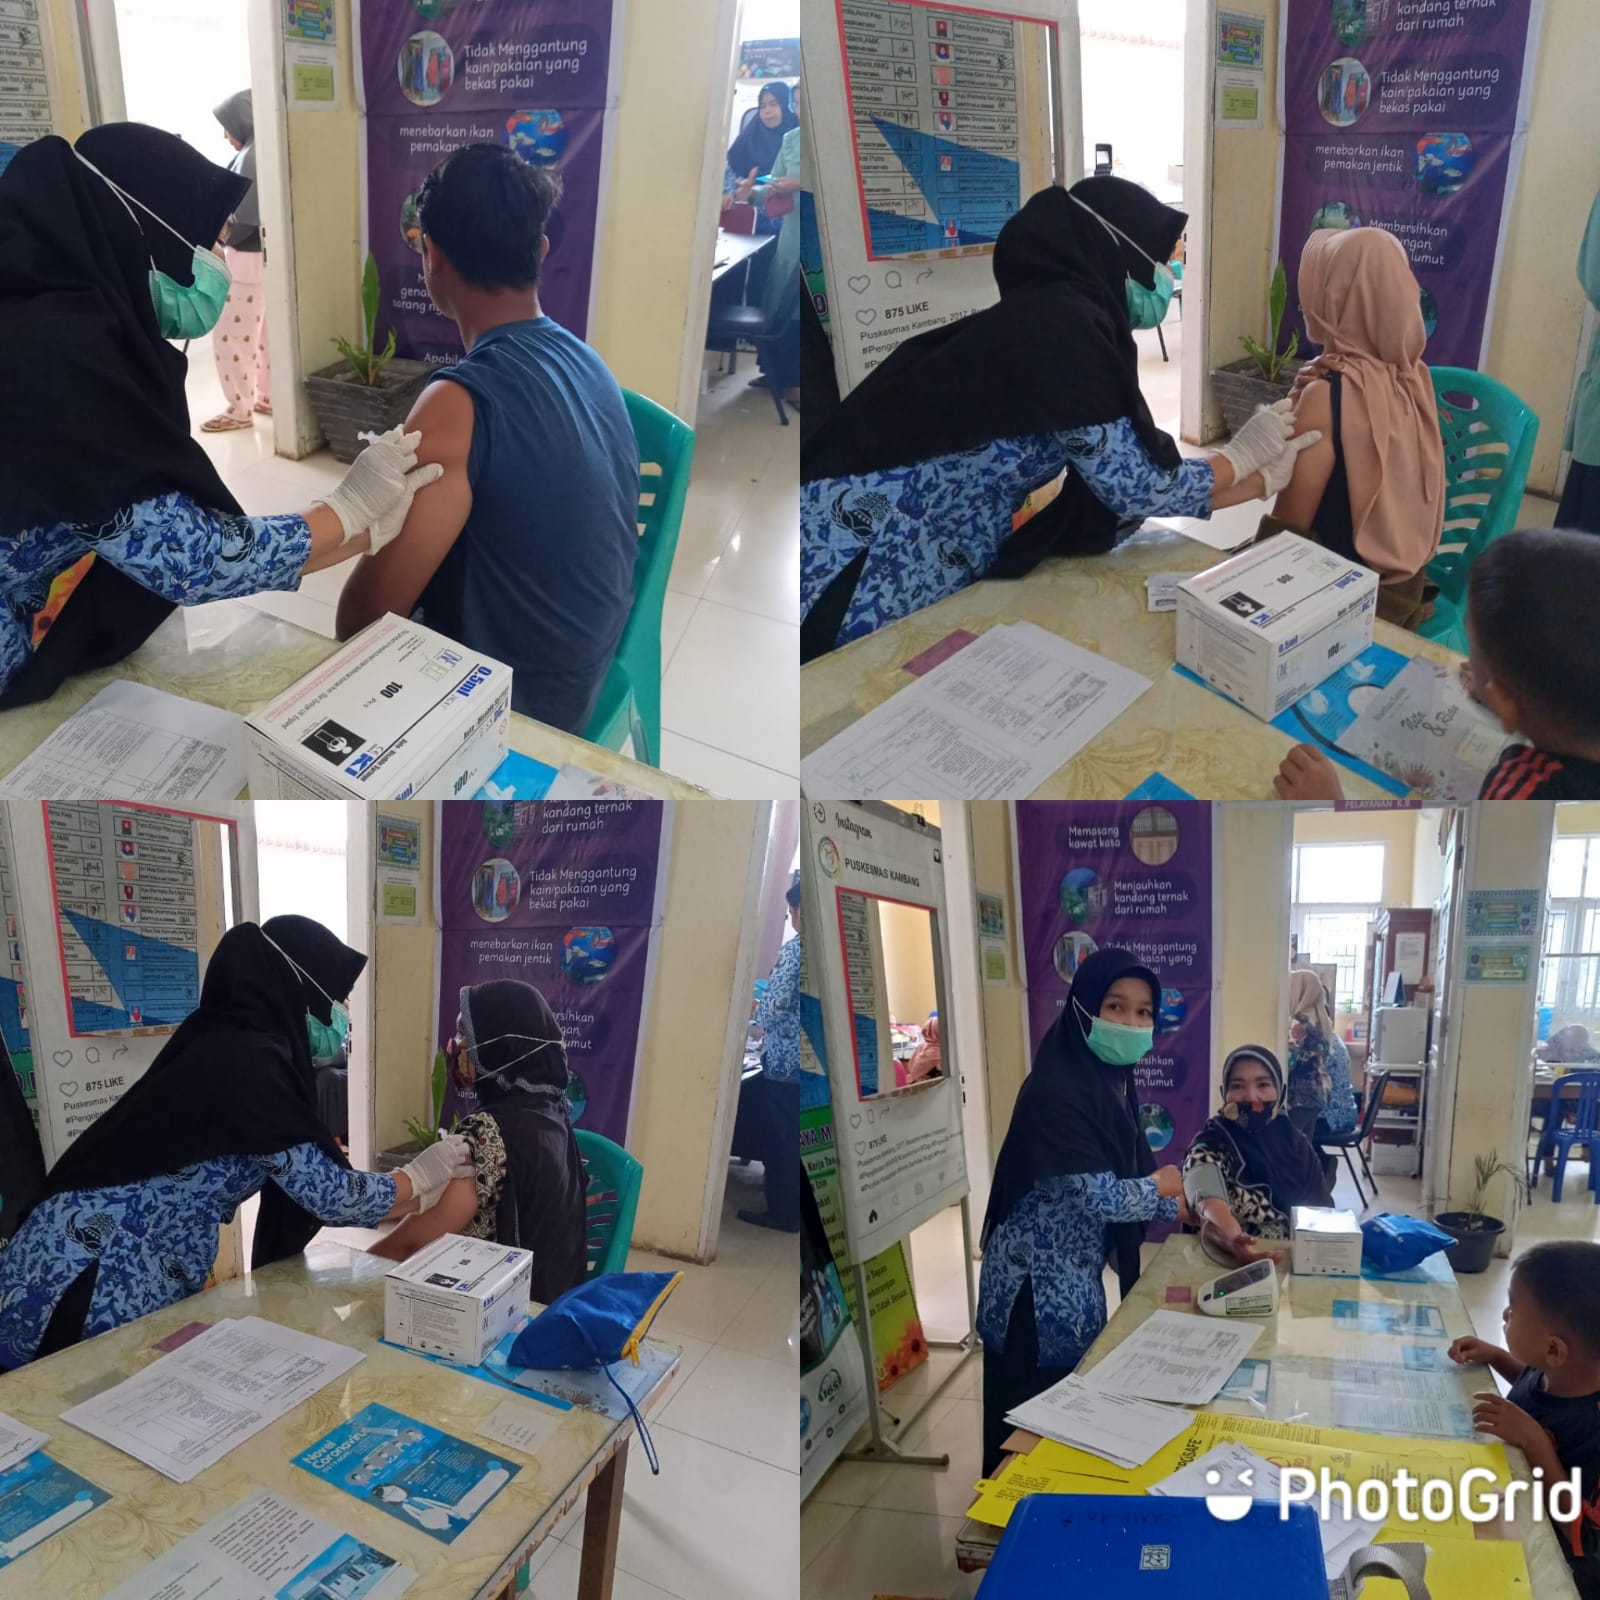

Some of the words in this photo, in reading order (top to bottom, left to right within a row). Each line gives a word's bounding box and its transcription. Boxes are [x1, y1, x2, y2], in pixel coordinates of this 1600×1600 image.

[1397, 0, 1450, 16] kandang
[1396, 17, 1420, 32] dari
[1422, 14, 1465, 30] rumah
[464, 42, 496, 58] Tidak
[498, 39, 588, 59] Menggantung
[545, 57, 580, 75] yang
[464, 76, 497, 90] bekas
[500, 74, 534, 93] pakai
[1381, 68, 1411, 83] Tidak
[1413, 67, 1500, 85] Menggantung
[1457, 85, 1492, 101] yang
[1379, 101, 1410, 113] bekas
[1412, 99, 1446, 117] pakai
[400, 123, 467, 138] menebarkan
[469, 123, 495, 138] ikan
[410, 138, 461, 156] pemakan
[1315, 143, 1378, 157] menebarkan
[1380, 143, 1405, 158] ikan
[1323, 157, 1371, 173] pemakan
[1371, 159, 1403, 175] jentik
[1411, 251, 1446, 265] lumut
[885, 307, 905, 320] 875
[906, 301, 929, 315] LIKE
[860, 326, 911, 341] Puskesmas
[424, 353, 461, 365] Apabil
[455, 665, 493, 697] 0.5ml
[379, 680, 404, 699] 100
[454, 770, 469, 795] 100
[543, 804, 591, 819] kandang
[594, 801, 633, 814] ternak
[1344, 800, 1393, 809] PELAYANAN
[542, 820, 564, 834] dari
[566, 816, 604, 831] rumah
[835, 812, 872, 840] Instagram
[1068, 826, 1119, 838] Memasang
[1068, 838, 1098, 849] kawat
[530, 868, 557, 881] Tidak
[559, 866, 637, 883] Menggantung
[844, 858, 889, 880] PUSKESMAS
[889, 870, 920, 887] KAMBANG
[600, 883, 631, 896] yang
[1114, 879, 1172, 894] Menjauhkan
[529, 897, 558, 910] bekas
[560, 896, 590, 912] pakai
[1114, 892, 1156, 904] kandang
[1157, 890, 1189, 902] ternak
[1114, 904, 1134, 915] dari
[1135, 903, 1167, 914] rumah
[470, 938, 529, 950] menebarkan
[531, 938, 553, 950] ikan
[1132, 941, 1198, 955] Menggantung
[479, 951, 522, 965] pemakan
[523, 952, 552, 967] jentik
[1168, 954, 1193, 966] yang
[85, 1080, 103, 1092] 875
[104, 1076, 125, 1088] LIKE
[1147, 1078, 1175, 1088] lumut
[63, 1099, 109, 1111] Puskesmas
[302, 1440, 337, 1464] Novel
[312, 1431, 368, 1469] Coronaviru
